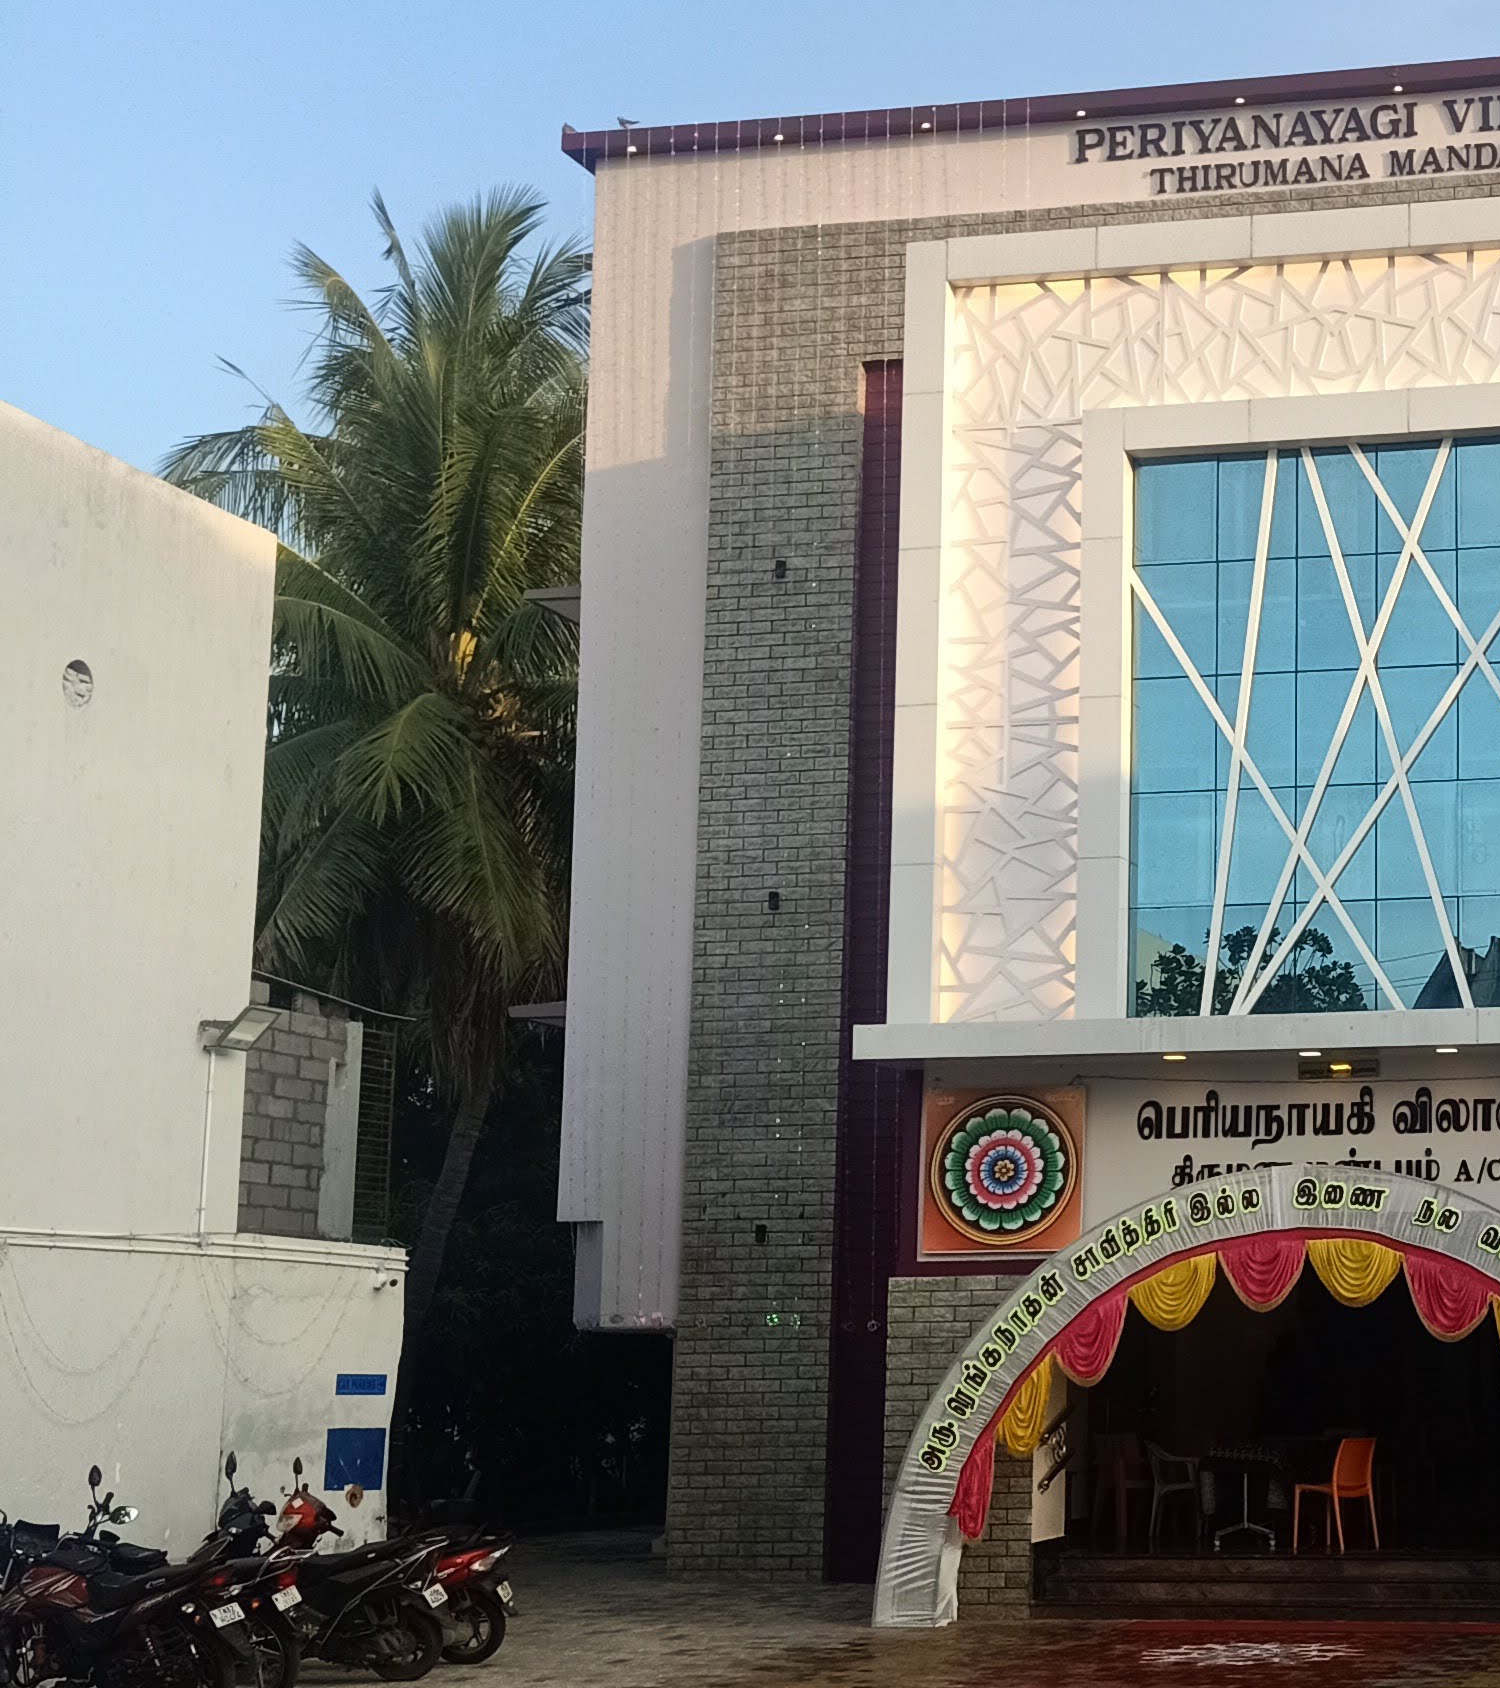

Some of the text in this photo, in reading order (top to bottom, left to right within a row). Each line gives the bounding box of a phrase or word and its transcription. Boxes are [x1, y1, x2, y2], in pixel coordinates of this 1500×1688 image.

[1074, 101, 1419, 164] PERIYANAYAGI
[1149, 152, 1371, 195] THIRUMANA
[1136, 1085, 1376, 1150] பெரியநாயகி
[1072, 1198, 1178, 1278] சாவித்திரி
[1188, 1187, 1261, 1223] இல்ல
[1294, 1177, 1387, 1209] இணை
[1413, 1198, 1460, 1230] நல
